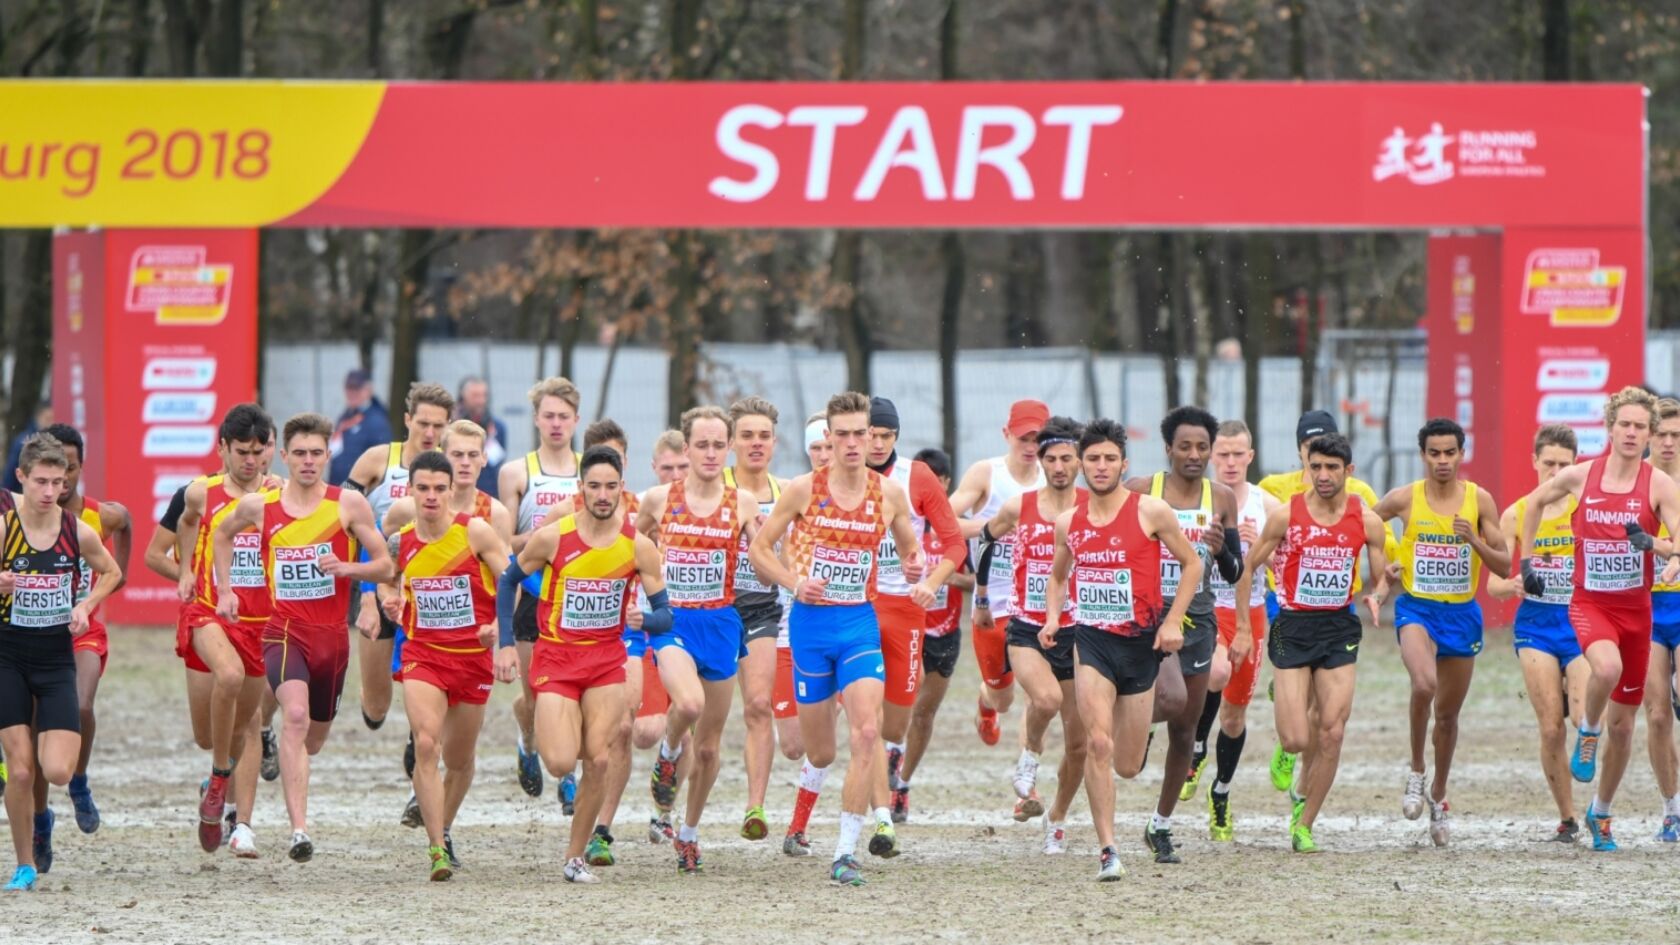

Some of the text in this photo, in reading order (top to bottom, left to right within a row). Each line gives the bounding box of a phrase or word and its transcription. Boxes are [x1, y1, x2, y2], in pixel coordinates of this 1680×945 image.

[119, 128, 272, 182] 2018
[708, 103, 1124, 203] START
[815, 515, 877, 533] Nederland
[1586, 508, 1640, 525] DANMARK
[667, 522, 733, 539] Nederland
[276, 547, 315, 560] SPAR
[816, 547, 859, 562] SPAR
[1416, 545, 1457, 557] SPAR
[1586, 542, 1628, 553] SPAR
[667, 550, 709, 563] SPAR
[1302, 557, 1343, 569] SPAR
[1588, 555, 1641, 573] JENSEN
[666, 565, 723, 583] NIESTEN
[812, 561, 869, 584] FOPPEN
[1416, 559, 1469, 576] GERGIS
[16, 576, 59, 588] SPAR
[1078, 569, 1113, 582] SPAR
[1301, 571, 1349, 589] ARAS
[412, 579, 453, 590] SPAR
[566, 580, 611, 592] SPAR
[14, 589, 70, 608] KERSTEN
[279, 589, 313, 598] TILBURG
[1079, 585, 1129, 604] GÜNEN
[565, 593, 620, 611] FONTES
[15, 615, 51, 625] TILBURG
[420, 615, 472, 627] TILBURG 2018
[1080, 611, 1111, 620] TILBURG
[566, 619, 601, 628] TILBURG
[905, 629, 920, 693] POLSKA
